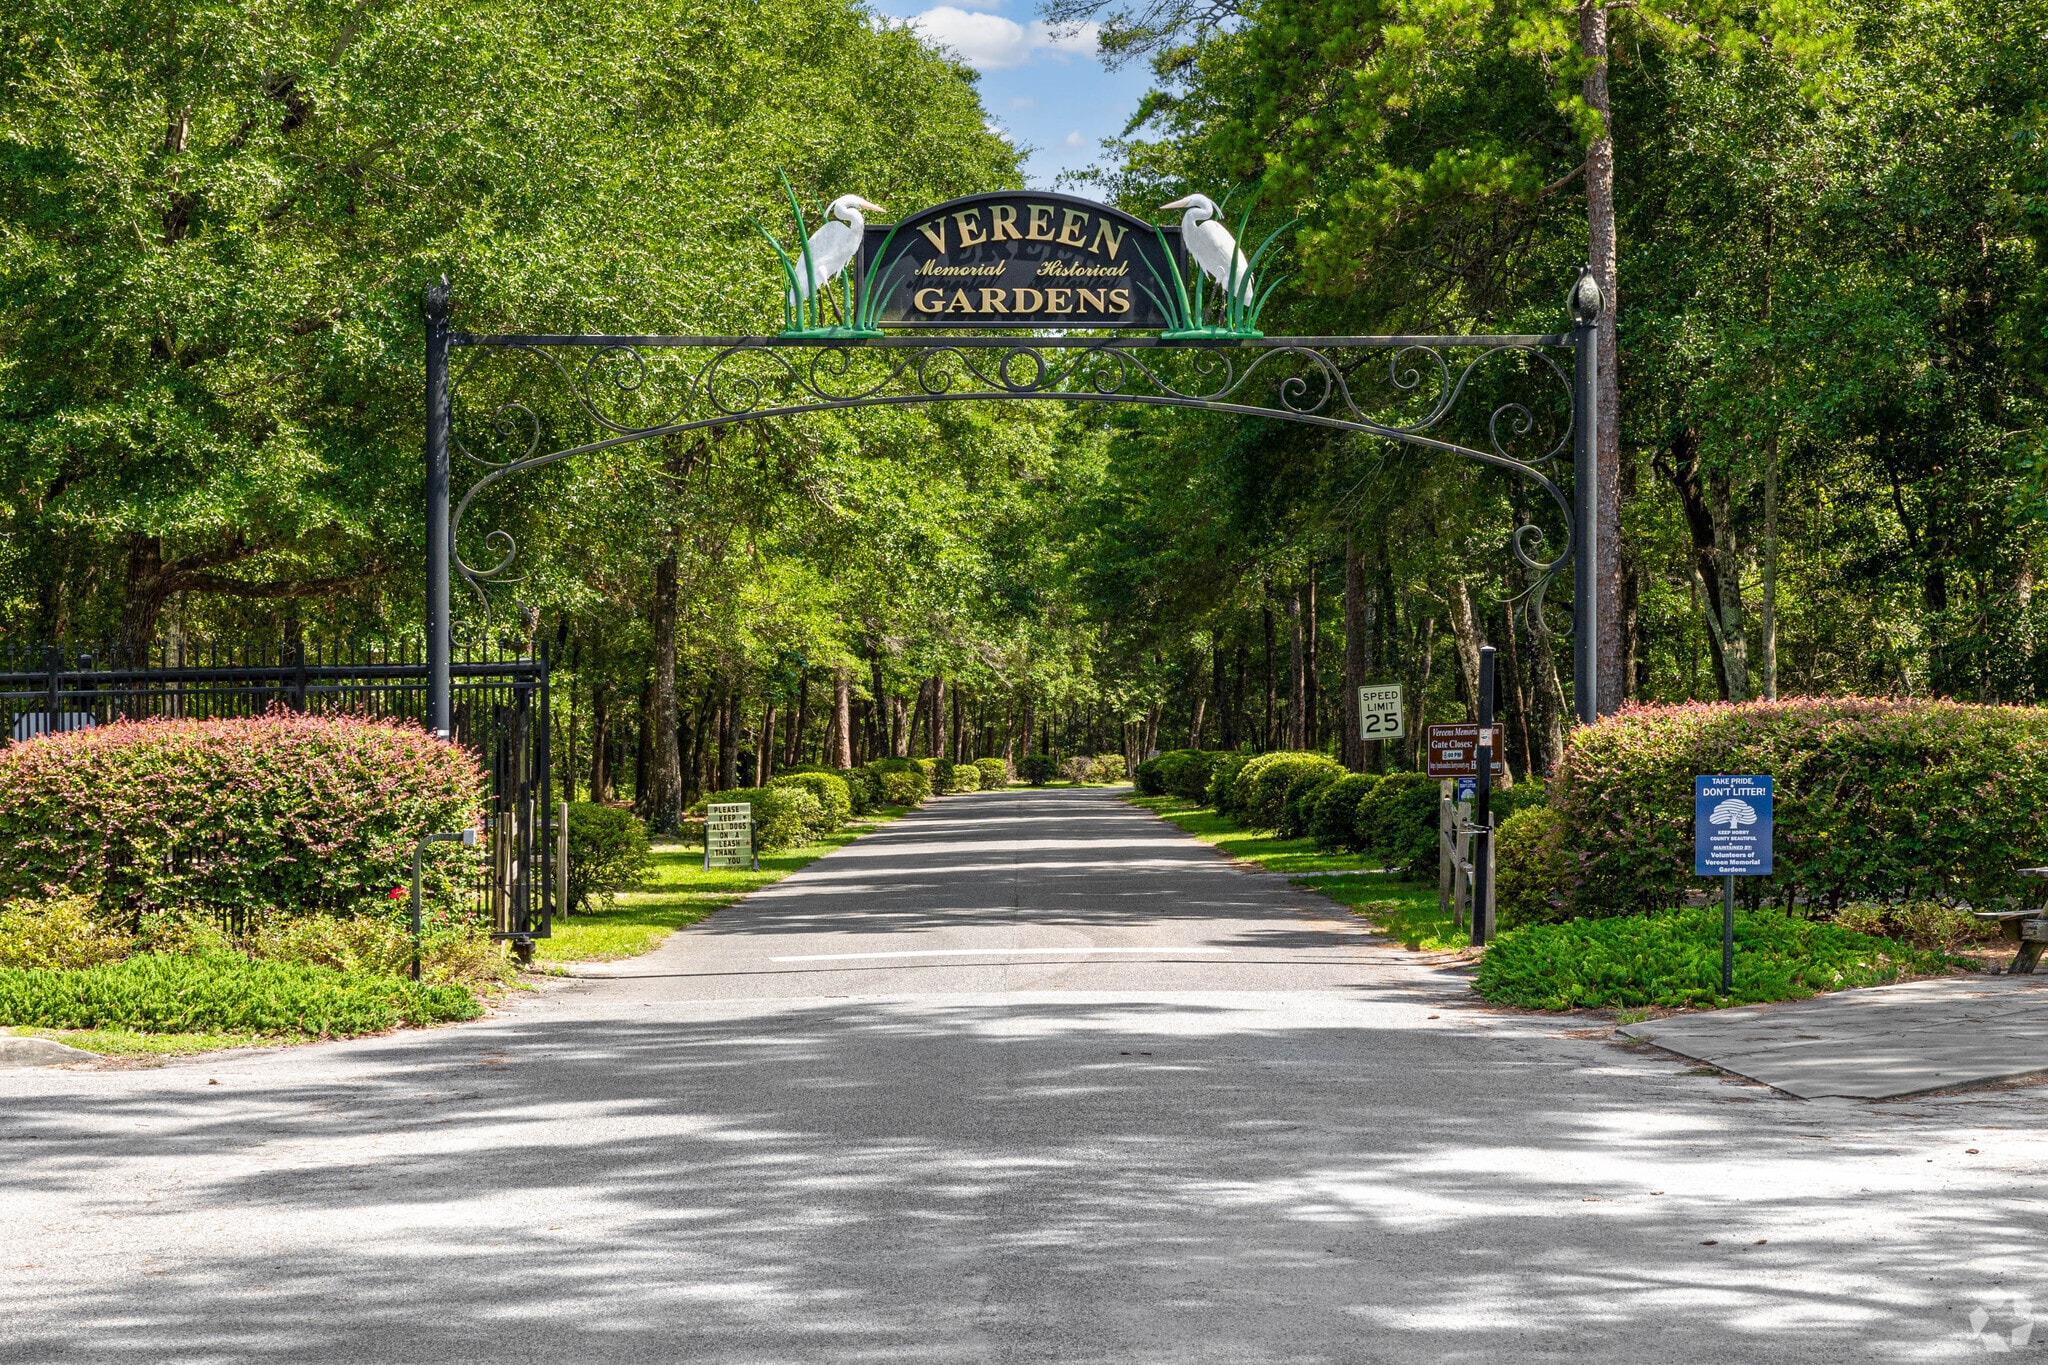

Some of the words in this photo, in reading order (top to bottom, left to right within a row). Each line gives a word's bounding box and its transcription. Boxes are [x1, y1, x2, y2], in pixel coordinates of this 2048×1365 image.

[916, 204, 1129, 260] VEREEN
[914, 259, 1006, 276] Memorial
[1036, 260, 1130, 277] Historical
[914, 287, 1131, 314] GARDENS
[1363, 691, 1398, 701] SPEED
[1367, 702, 1394, 711] LIMIT
[1365, 712, 1399, 733] 25
[1433, 728, 1454, 736] Vereens
[1431, 740, 1448, 749] Gate
[1449, 740, 1473, 748] Closes:
[1703, 788, 1731, 796] DON'T
[1733, 788, 1766, 796] LITTER!
[730, 822, 747, 830] DOGS
